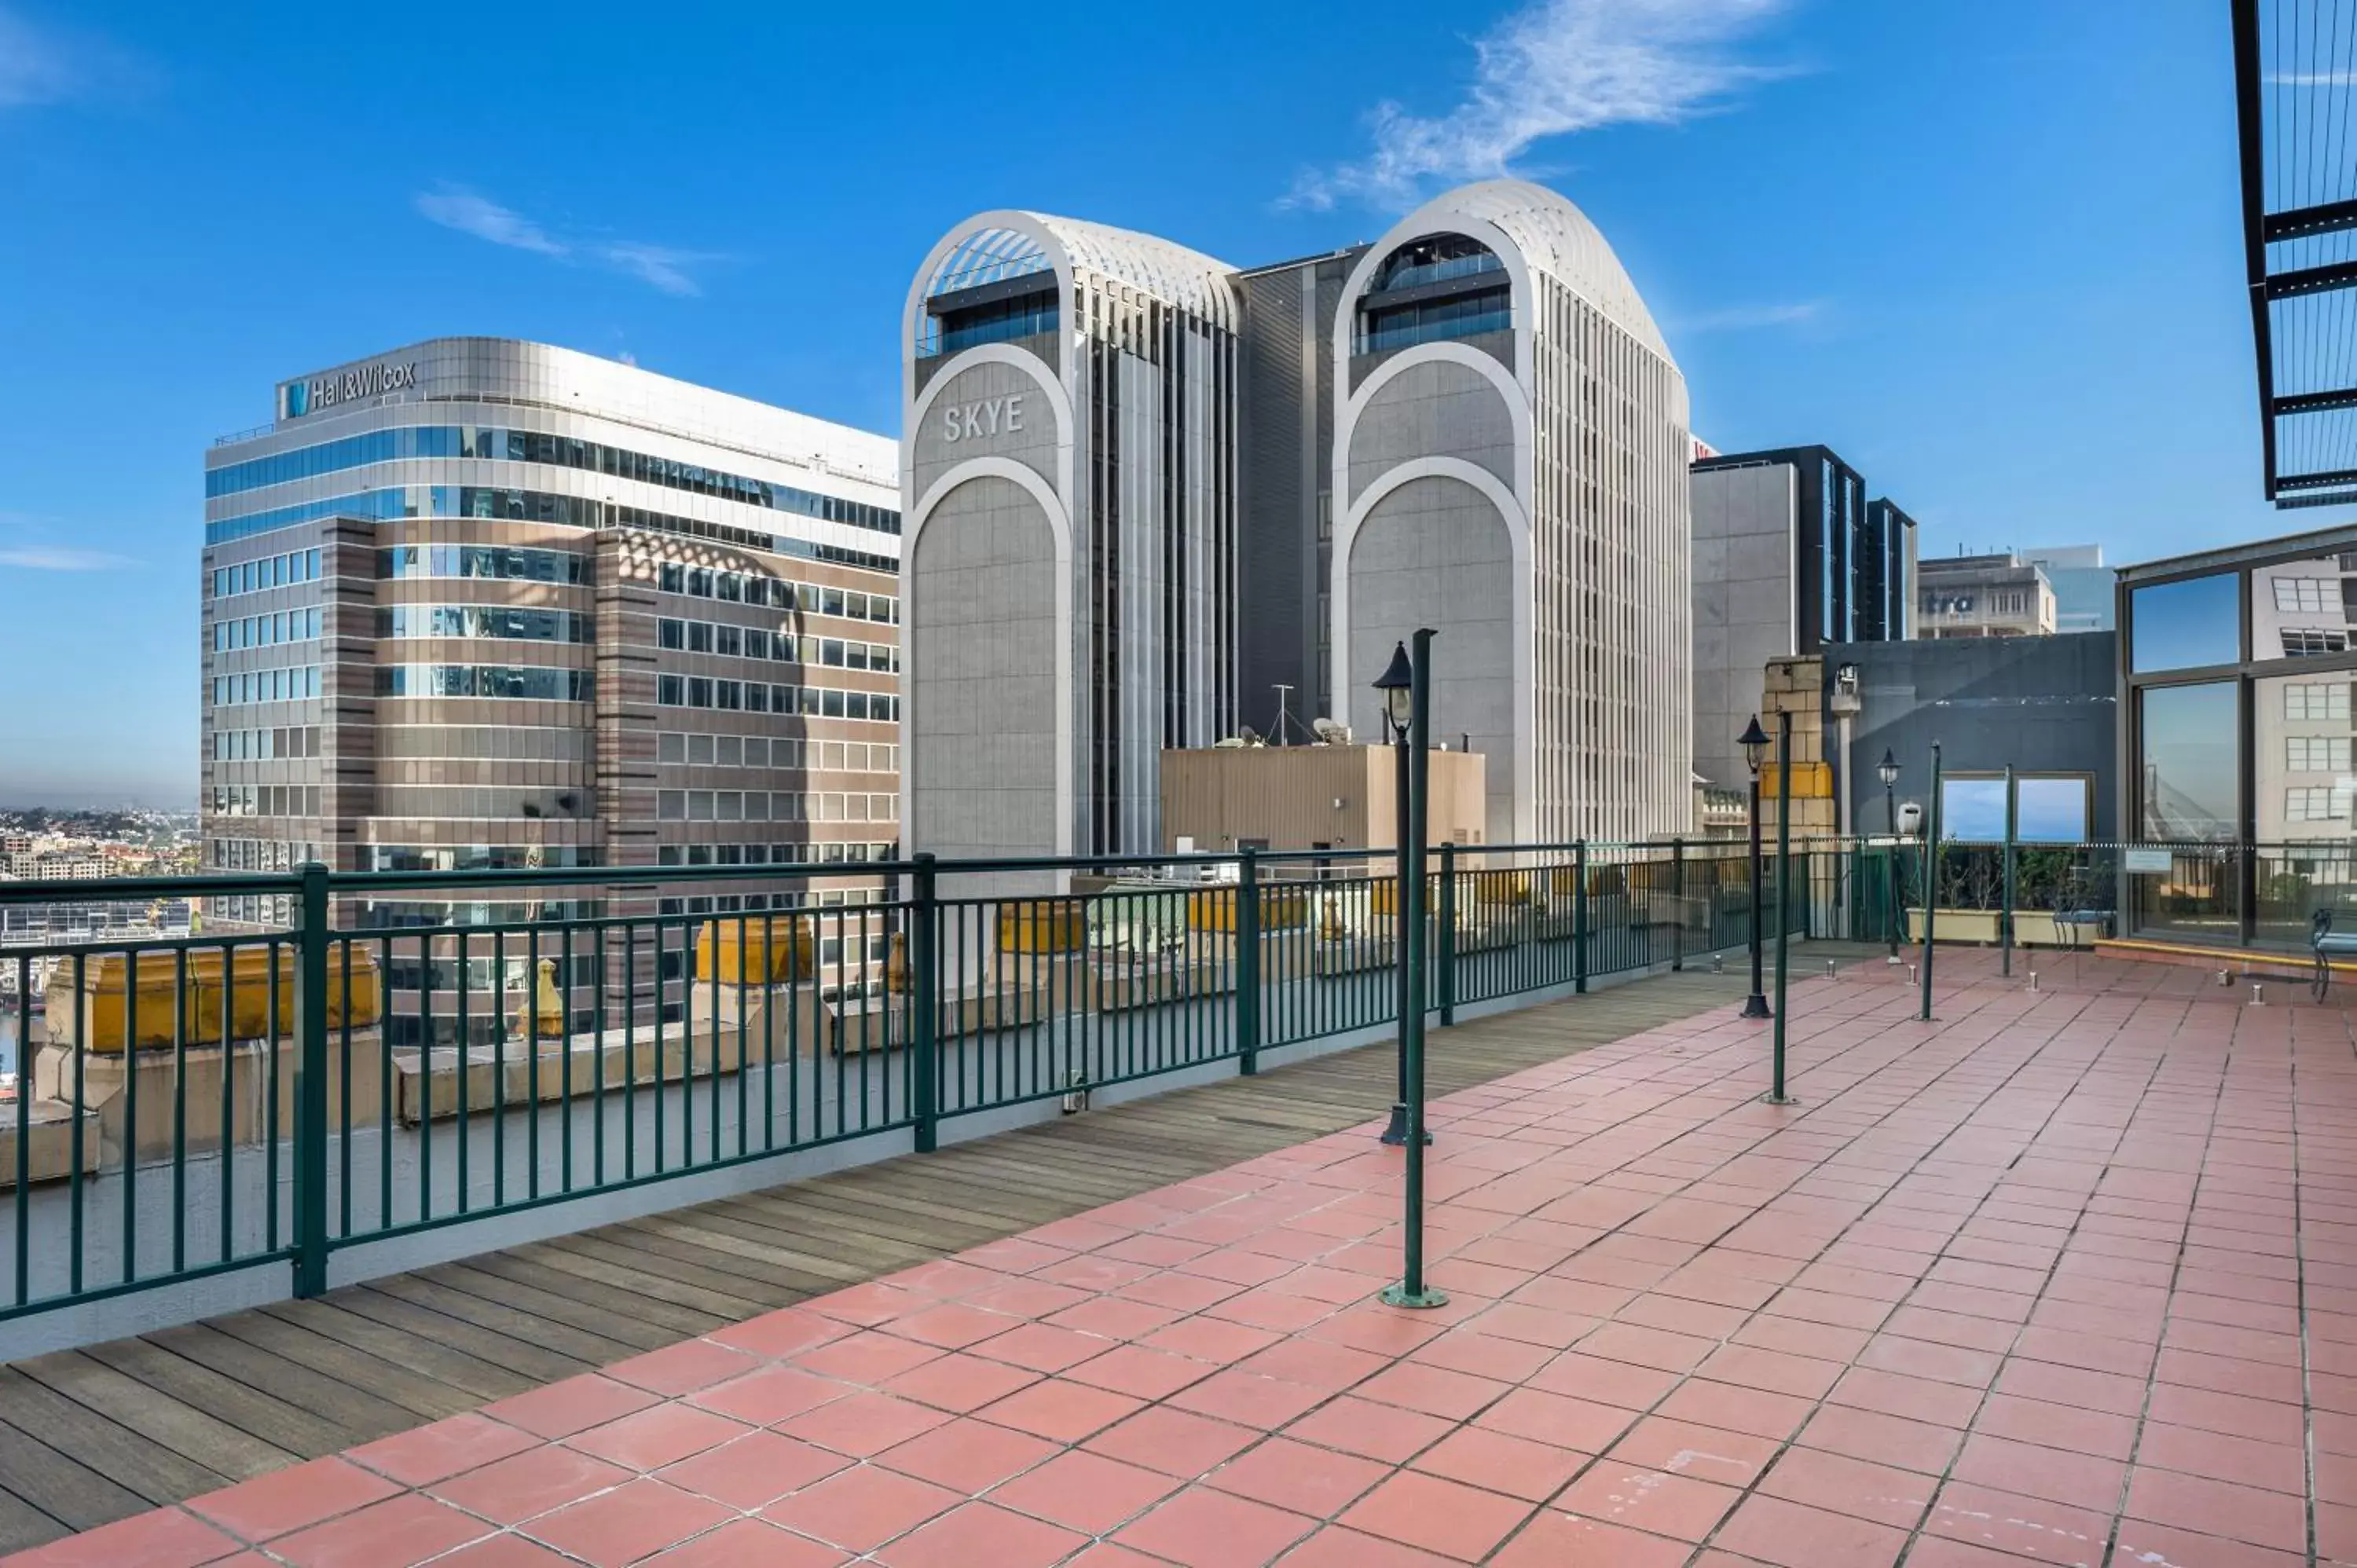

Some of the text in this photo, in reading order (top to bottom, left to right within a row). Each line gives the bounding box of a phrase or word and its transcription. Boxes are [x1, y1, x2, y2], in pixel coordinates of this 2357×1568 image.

[313, 362, 415, 408] Hall&Wilcox
[944, 396, 1023, 442] SKYE
[1918, 593, 1974, 614] tra
